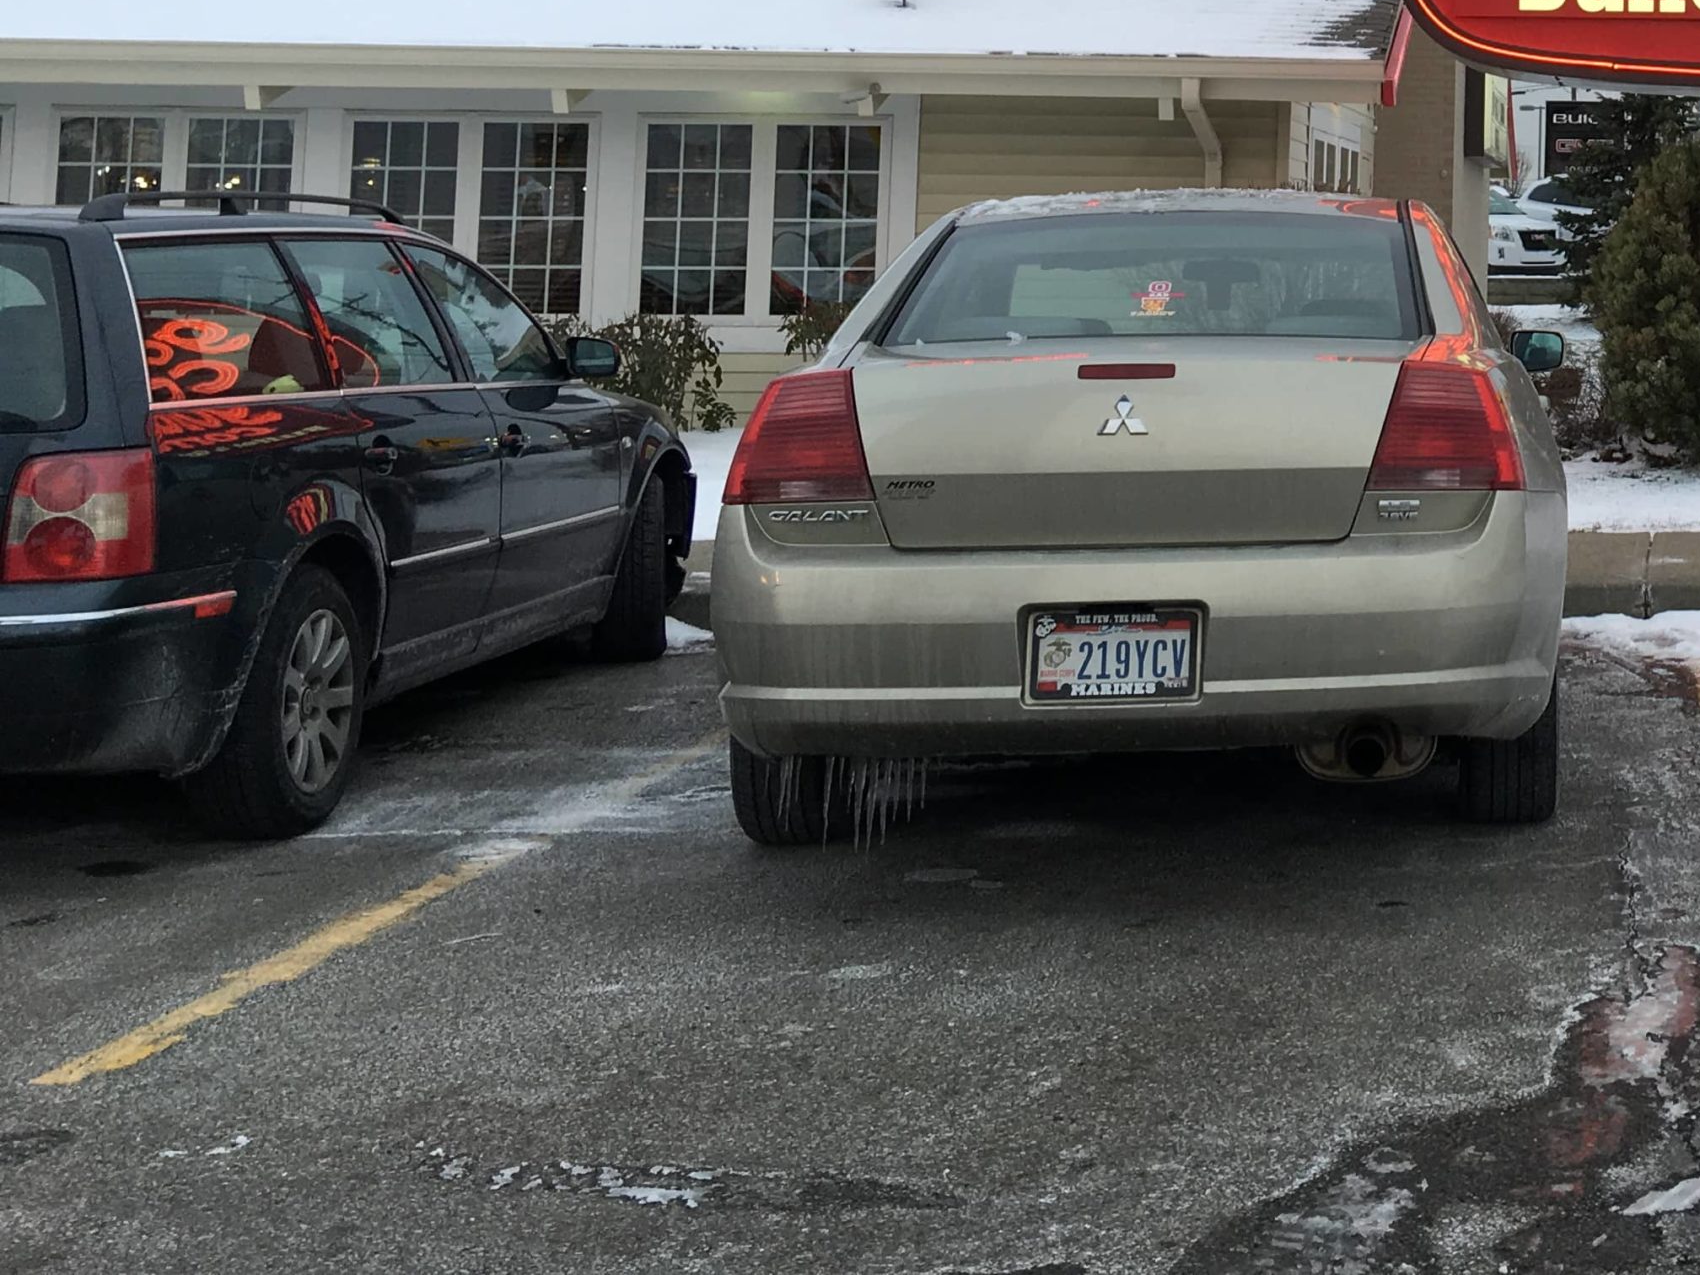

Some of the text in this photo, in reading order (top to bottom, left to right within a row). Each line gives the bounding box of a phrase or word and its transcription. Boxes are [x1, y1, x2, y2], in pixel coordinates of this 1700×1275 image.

[886, 480, 936, 489] METRO
[768, 509, 869, 522] GALANT
[1075, 615, 1091, 623] THE
[1114, 614, 1129, 623] THE
[1078, 639, 1186, 679] 219YCV
[1070, 681, 1157, 696] MARINES
